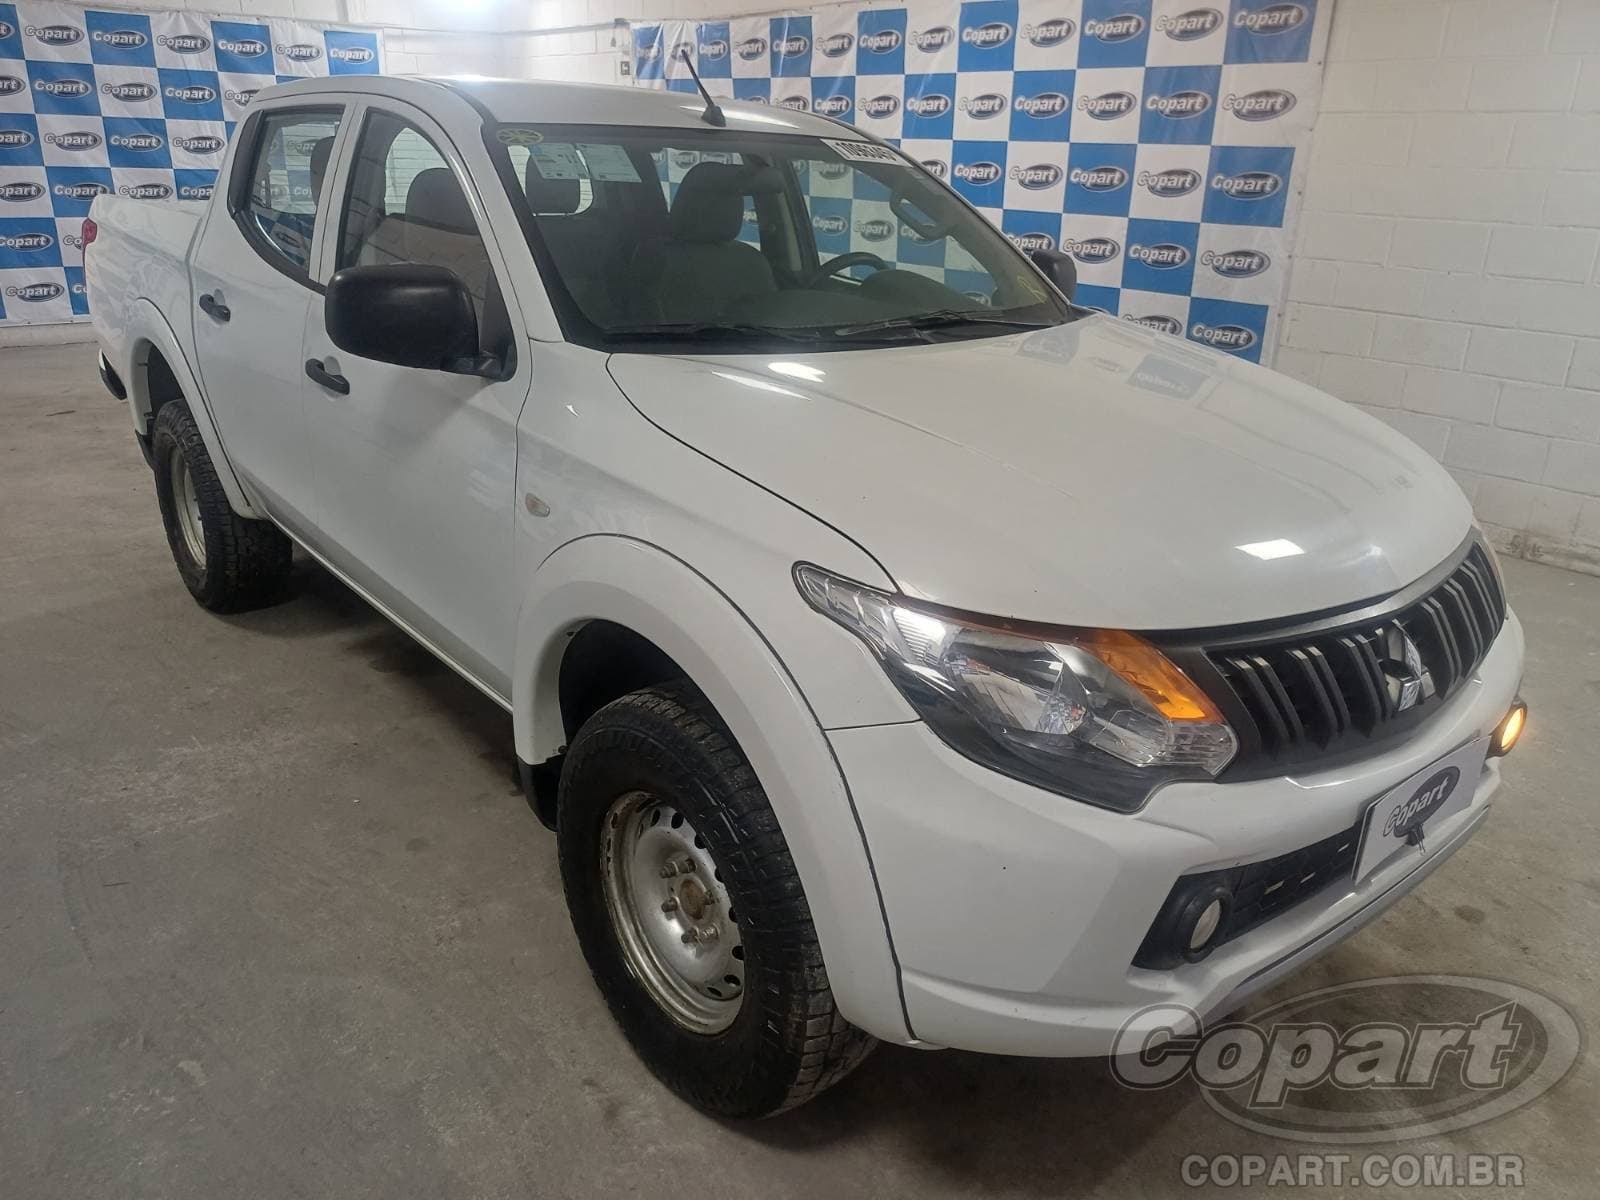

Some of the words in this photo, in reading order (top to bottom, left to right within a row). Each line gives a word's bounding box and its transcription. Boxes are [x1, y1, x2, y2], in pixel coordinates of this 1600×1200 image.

[1155, 13, 1213, 33] Copart
[1233, 6, 1299, 27] Copart
[25, 25, 77, 41] Copart
[962, 26, 1008, 42] Copart
[1020, 22, 1069, 39] Copart
[1084, 18, 1138, 35] Copart
[93, 31, 142, 45] Copart
[157, 35, 202, 49] Copart
[860, 33, 897, 47] Copart
[908, 30, 950, 46] Copart
[218, 40, 261, 54] Copart
[276, 44, 318, 57] Copart
[330, 48, 369, 61] Copart
[35, 80, 86, 95] Copart
[101, 84, 149, 98] Copart
[165, 87, 210, 101] Copart
[858, 98, 898, 113] Copart
[907, 97, 948, 113] Copart
[959, 97, 1001, 114] Copart
[1015, 96, 1062, 113] Copart
[1077, 95, 1128, 112] Copart
[1146, 94, 1203, 111] Copart
[1222, 93, 1284, 113] Copart
[44, 133, 95, 149] Copart
[110, 136, 157, 150] Copart
[173, 134, 217, 149] Copart
[954, 164, 997, 181] Copart
[1009, 166, 1056, 183] Copart
[1070, 168, 1121, 185] Copart
[1136, 171, 1193, 189] Copart
[0, 184, 37, 199] opart
[54, 185, 102, 199] Copart
[1211, 175, 1274, 193] Copart
[119, 186, 166, 199] Copart
[812, 216, 844, 232] Copart
[854, 220, 889, 236] Copart
[1063, 239, 1113, 256] Copart
[1129, 243, 1183, 262] Copart
[1201, 249, 1261, 270] Copart
[6, 285, 57, 300] Copart
[1191, 323, 1249, 345] Copart
[1383, 776, 1450, 837] Copart
